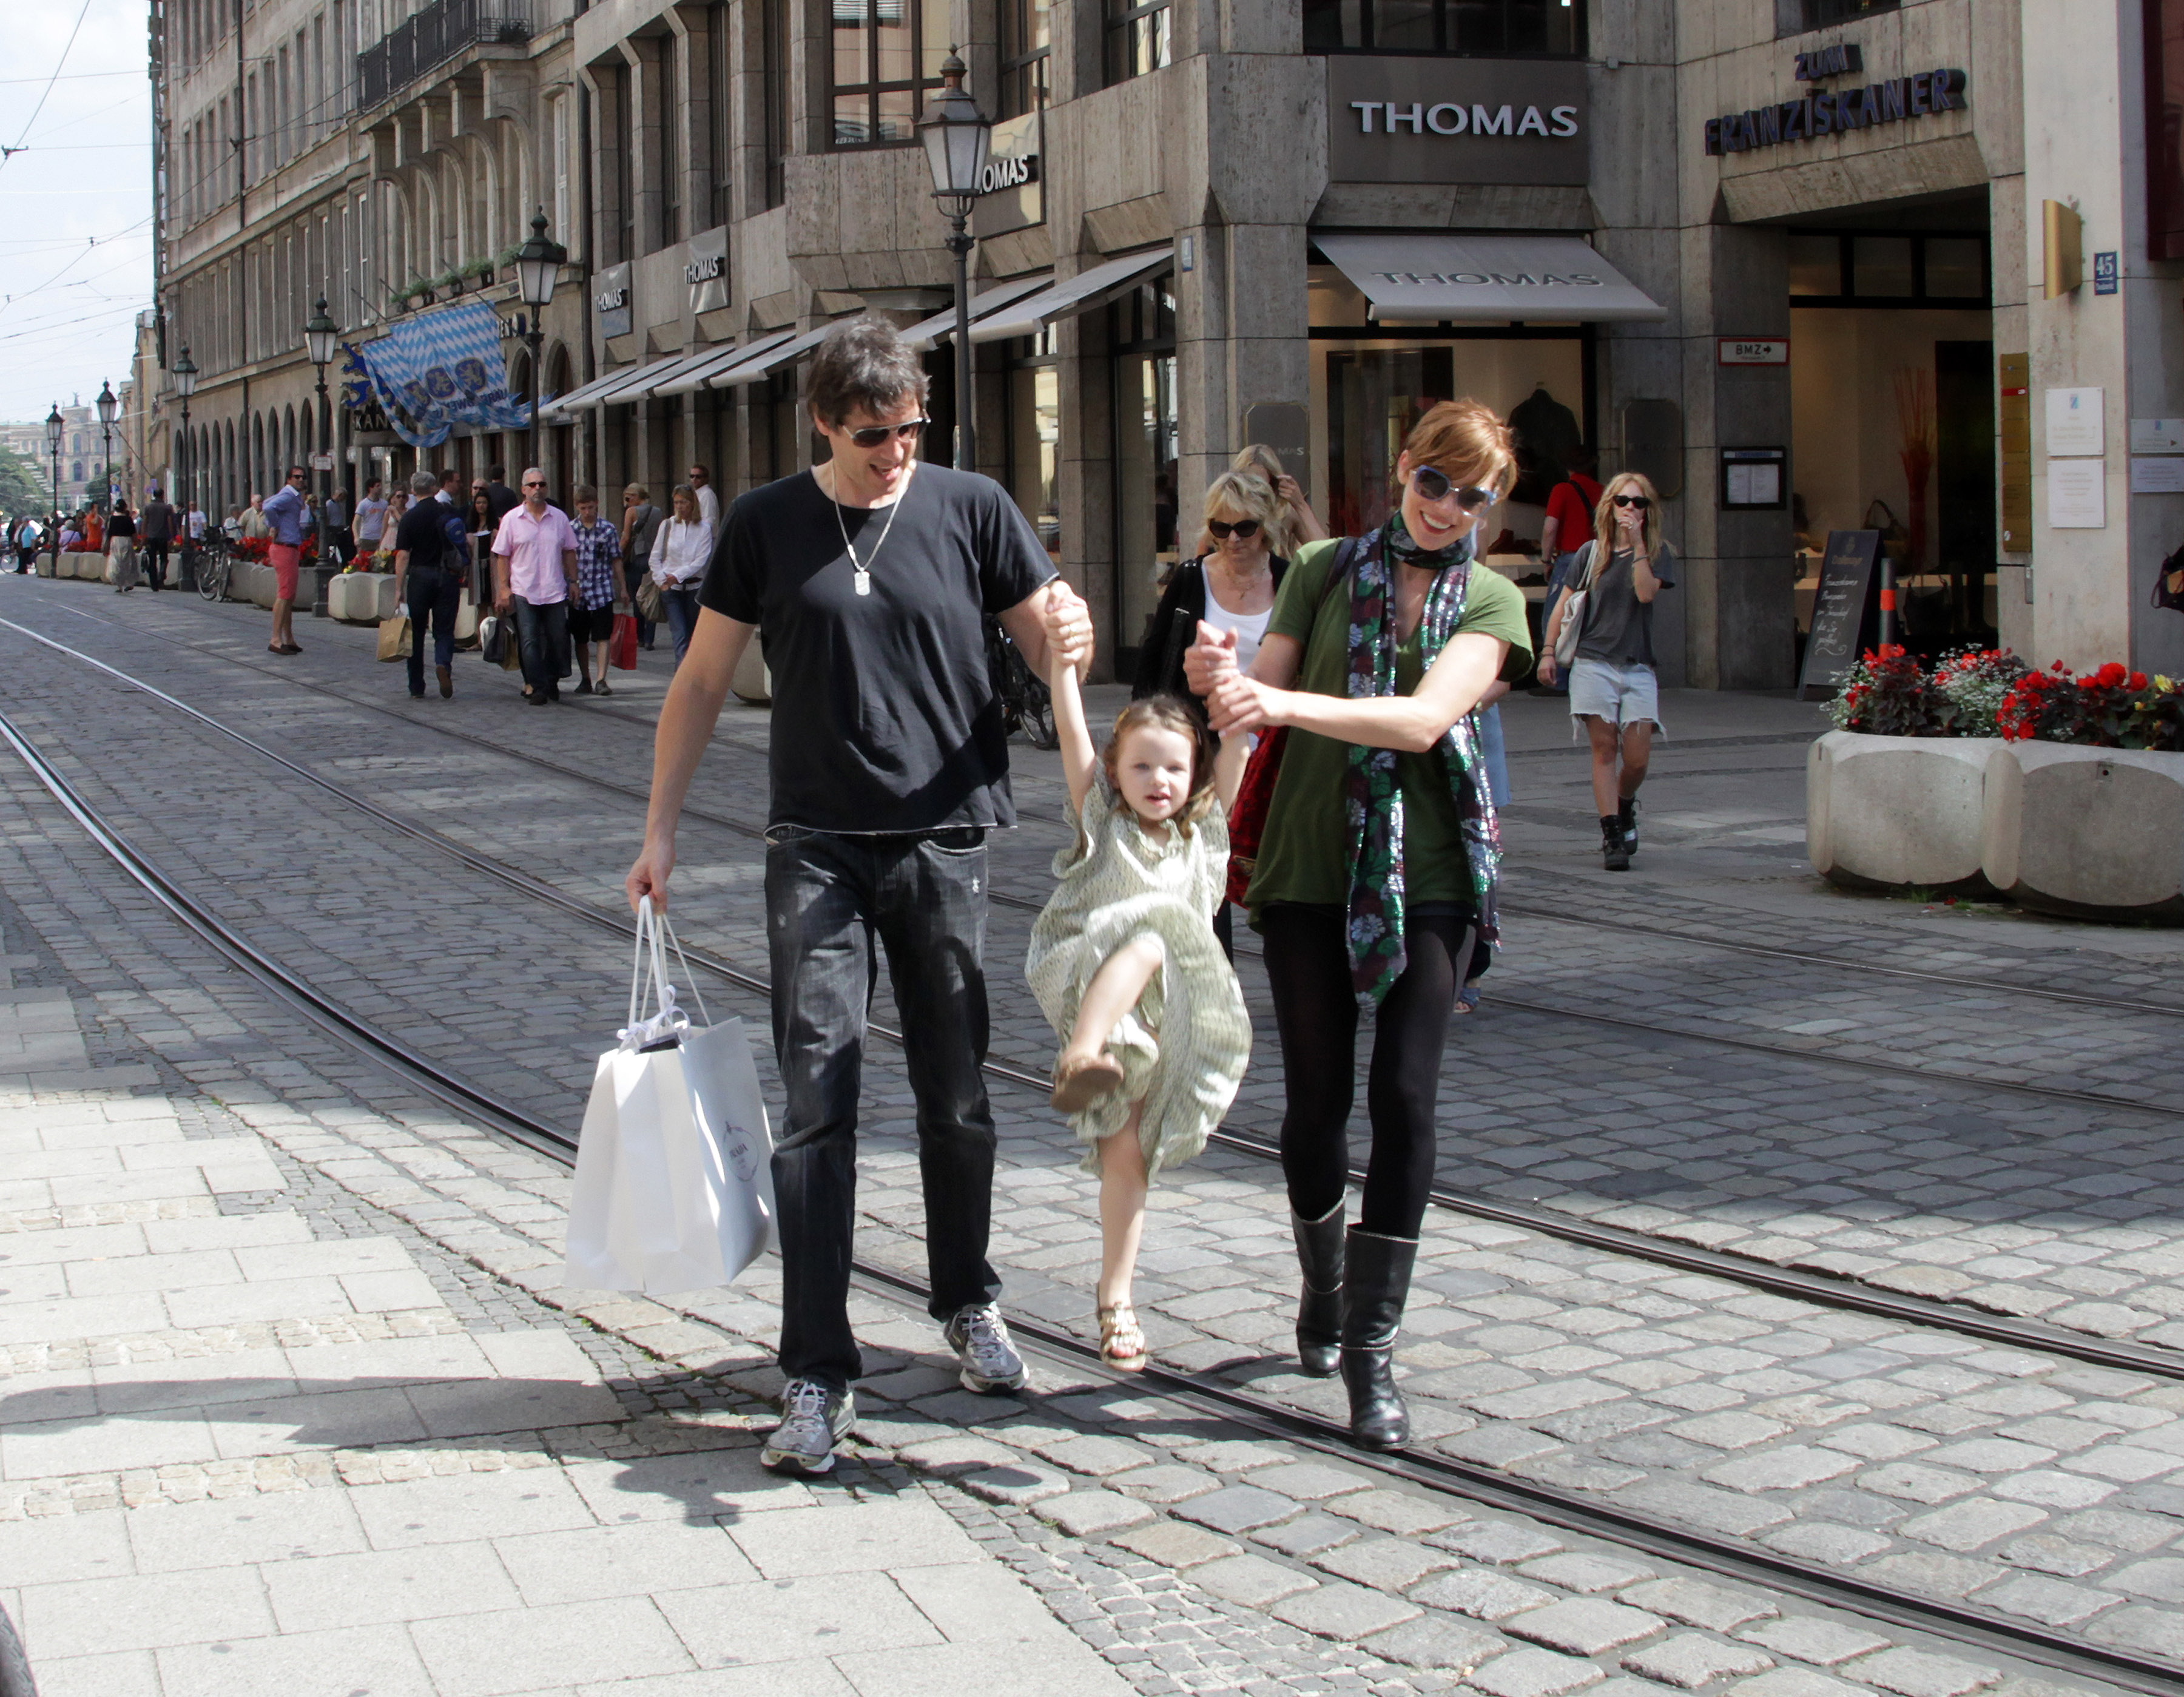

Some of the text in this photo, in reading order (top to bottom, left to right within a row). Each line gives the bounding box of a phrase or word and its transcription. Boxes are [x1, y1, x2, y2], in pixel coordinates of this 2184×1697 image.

[1795, 44, 1858, 81] ZUM
[1351, 101, 1578, 137] THOMAS
[1705, 69, 1964, 155] FRANZISKANER
[980, 154, 1028, 195] OMAS
[684, 255, 720, 285] THOMAS
[1371, 272, 1604, 287] THOMAS
[2096, 255, 2114, 275] 45
[595, 287, 623, 313] THOMAS
[1736, 344, 1762, 355] BMZ
